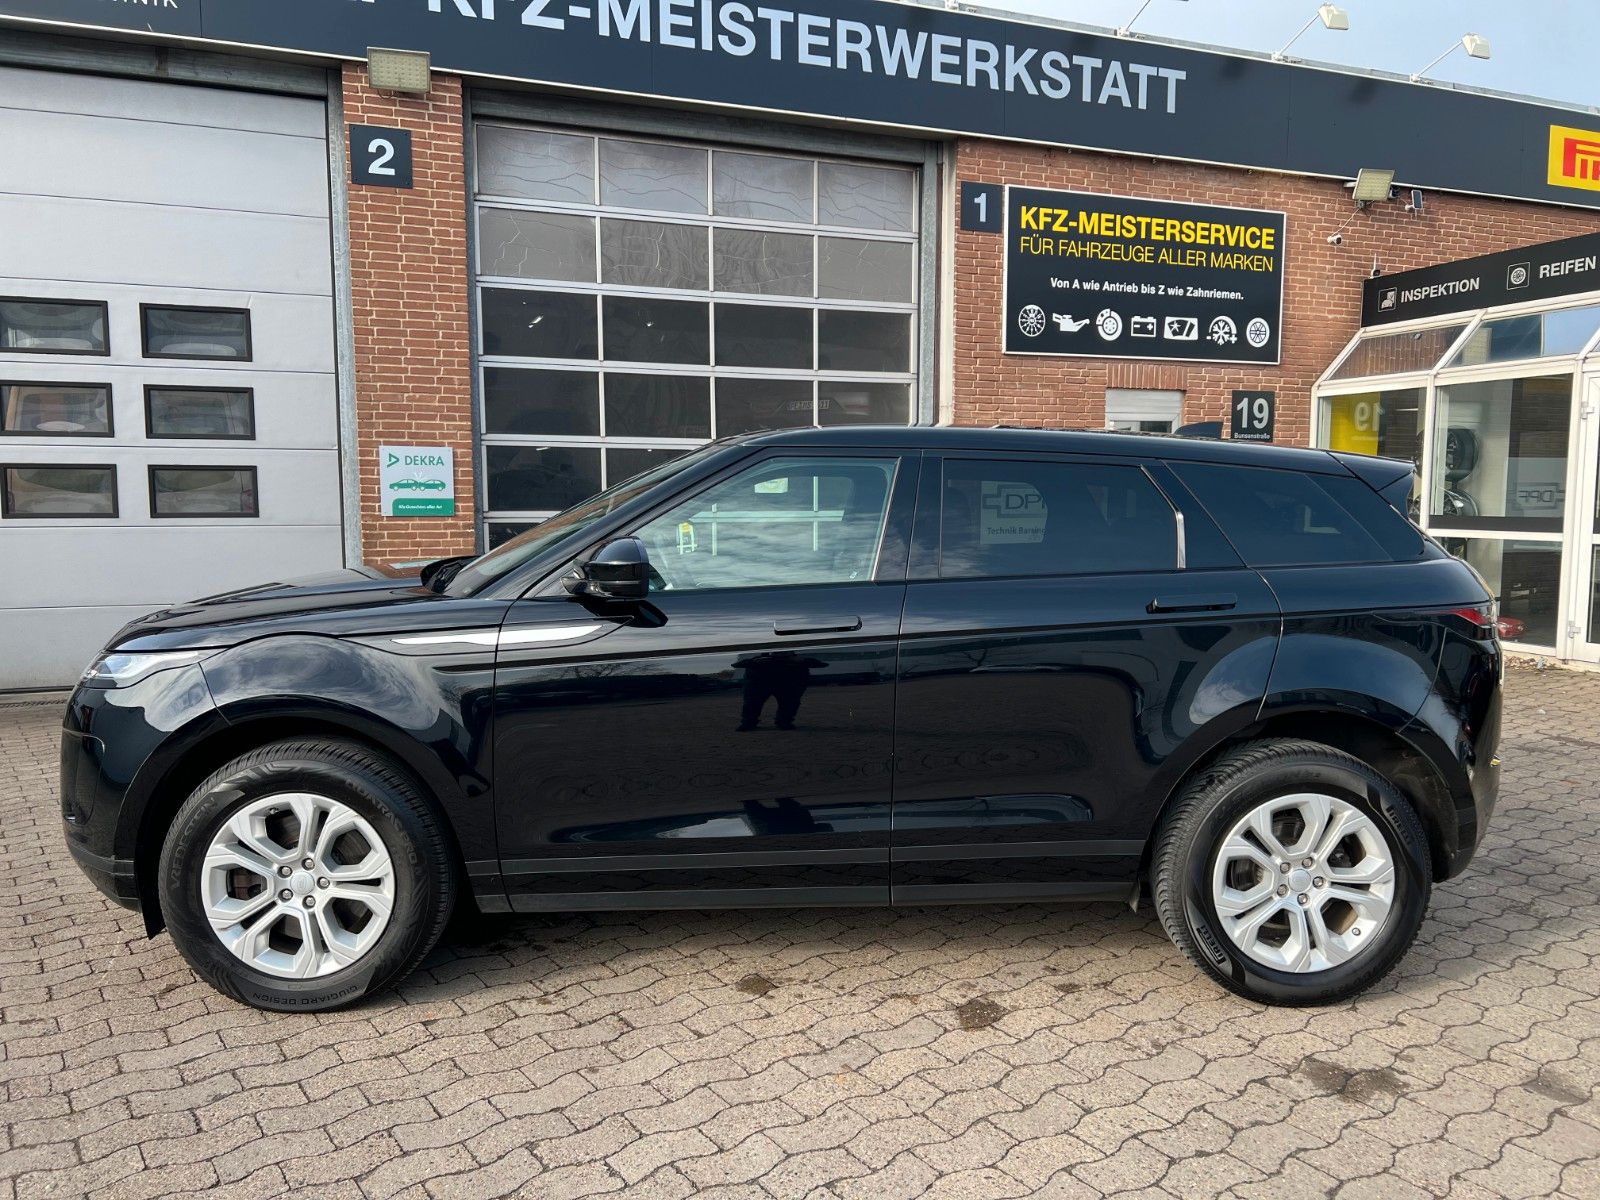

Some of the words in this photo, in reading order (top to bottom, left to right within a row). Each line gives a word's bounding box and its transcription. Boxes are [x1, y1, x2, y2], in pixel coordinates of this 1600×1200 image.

[427, 0, 1187, 114] Z-MEISTERWERKSTATT
[367, 138, 396, 176] 2
[973, 192, 987, 223] 1
[1020, 205, 1275, 250] KFZ-MEISTERSERVICE
[1020, 233, 1054, 255] FÜR
[1058, 239, 1154, 263] FAHRZEUGE
[1158, 248, 1207, 267] ALLER
[1210, 252, 1273, 272] MARKEN
[1539, 255, 1597, 279] REIFEN
[1050, 277, 1070, 289] Von
[1072, 279, 1081, 289] A
[1083, 280, 1100, 291] wie
[1102, 281, 1139, 294] Antrieb
[1141, 284, 1156, 295] bis
[1158, 285, 1166, 295] Z
[1168, 286, 1184, 297] wie
[1186, 287, 1244, 300] Zahnriemen.
[1400, 276, 1480, 303] INSPEKTION
[1236, 397, 1269, 429] 19
[404, 455, 445, 466] DEKRA
[252, 992, 297, 1005] DESIGN
